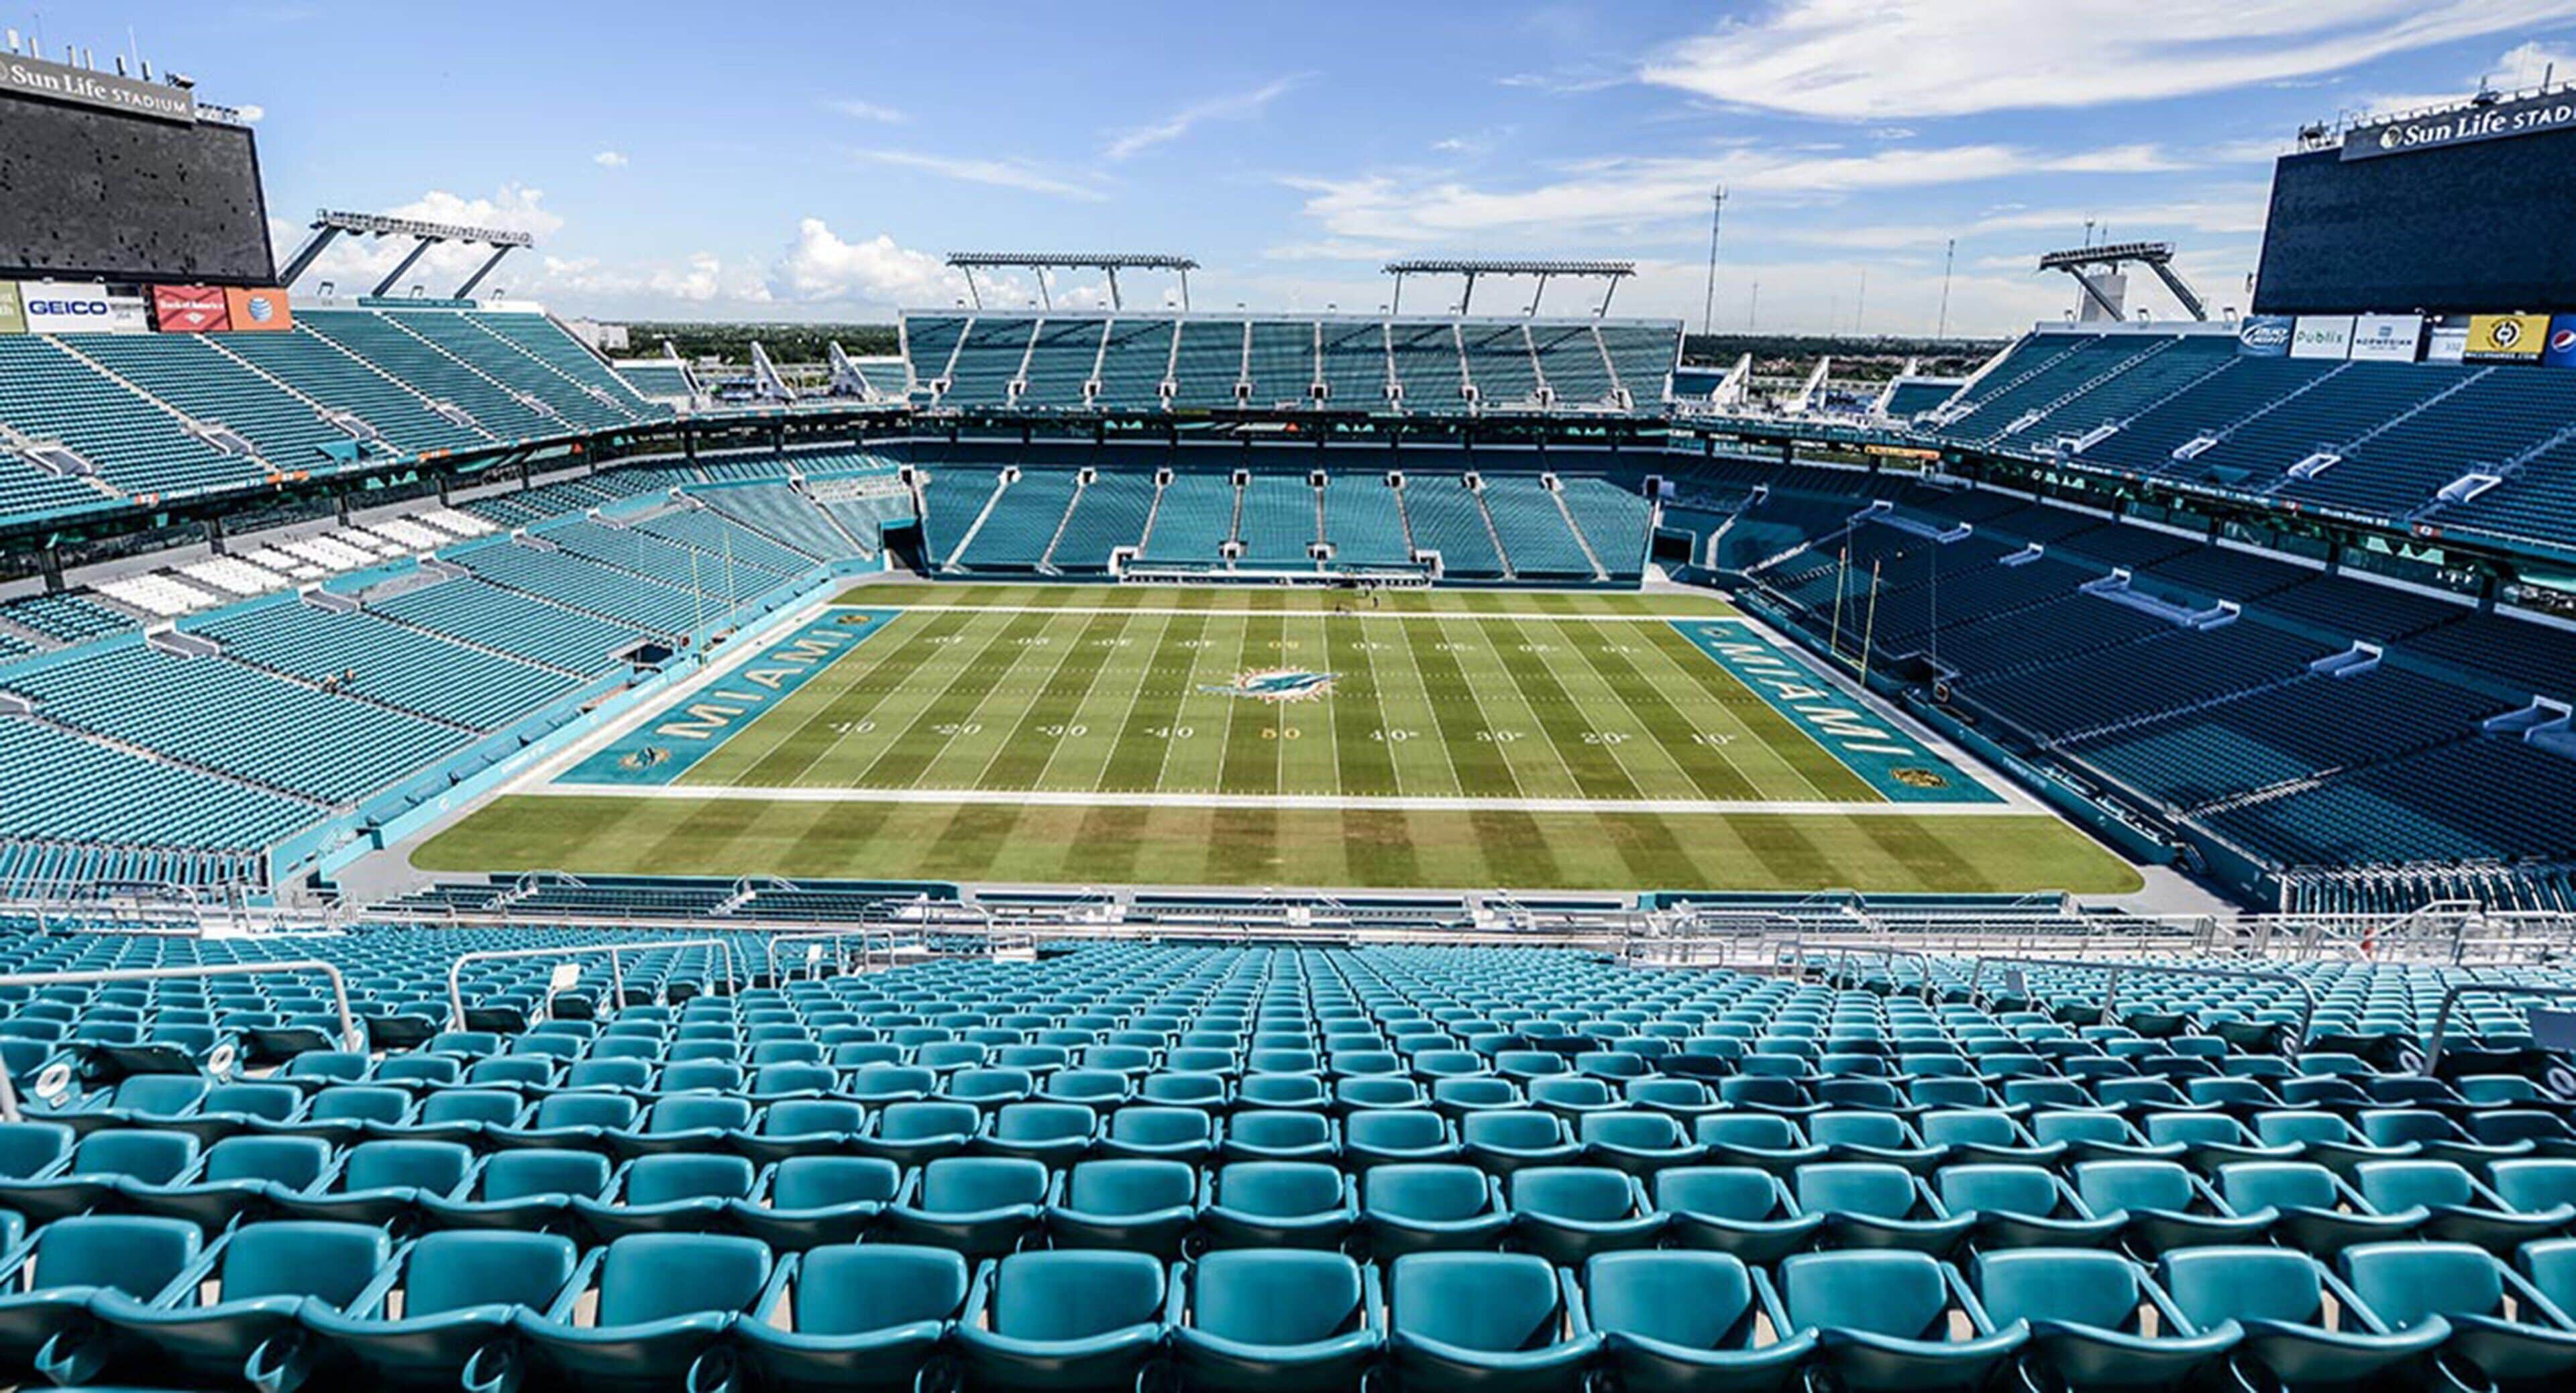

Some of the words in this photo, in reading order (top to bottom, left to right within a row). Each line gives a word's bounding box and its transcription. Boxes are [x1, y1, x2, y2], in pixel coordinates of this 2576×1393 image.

[11, 64, 59, 90] Sun
[64, 74, 108, 100] Life
[111, 89, 187, 113] STADIUM
[2404, 125, 2450, 146] Sun
[2456, 110, 2507, 137] Life
[28, 300, 107, 315] GEICO
[2296, 331, 2343, 344] Publix
[655, 628, 856, 739] MIAMI
[1710, 640, 1916, 756] MIAMI
[838, 721, 875, 733] 10
[945, 723, 982, 735] 20
[1046, 724, 1087, 736] 30
[1153, 726, 1193, 738] 40
[1262, 727, 1301, 739] 50
[1371, 728, 1408, 741] 40
[1477, 730, 1514, 742] 30
[1582, 732, 1621, 744] 20
[1692, 733, 1729, 744] 10
